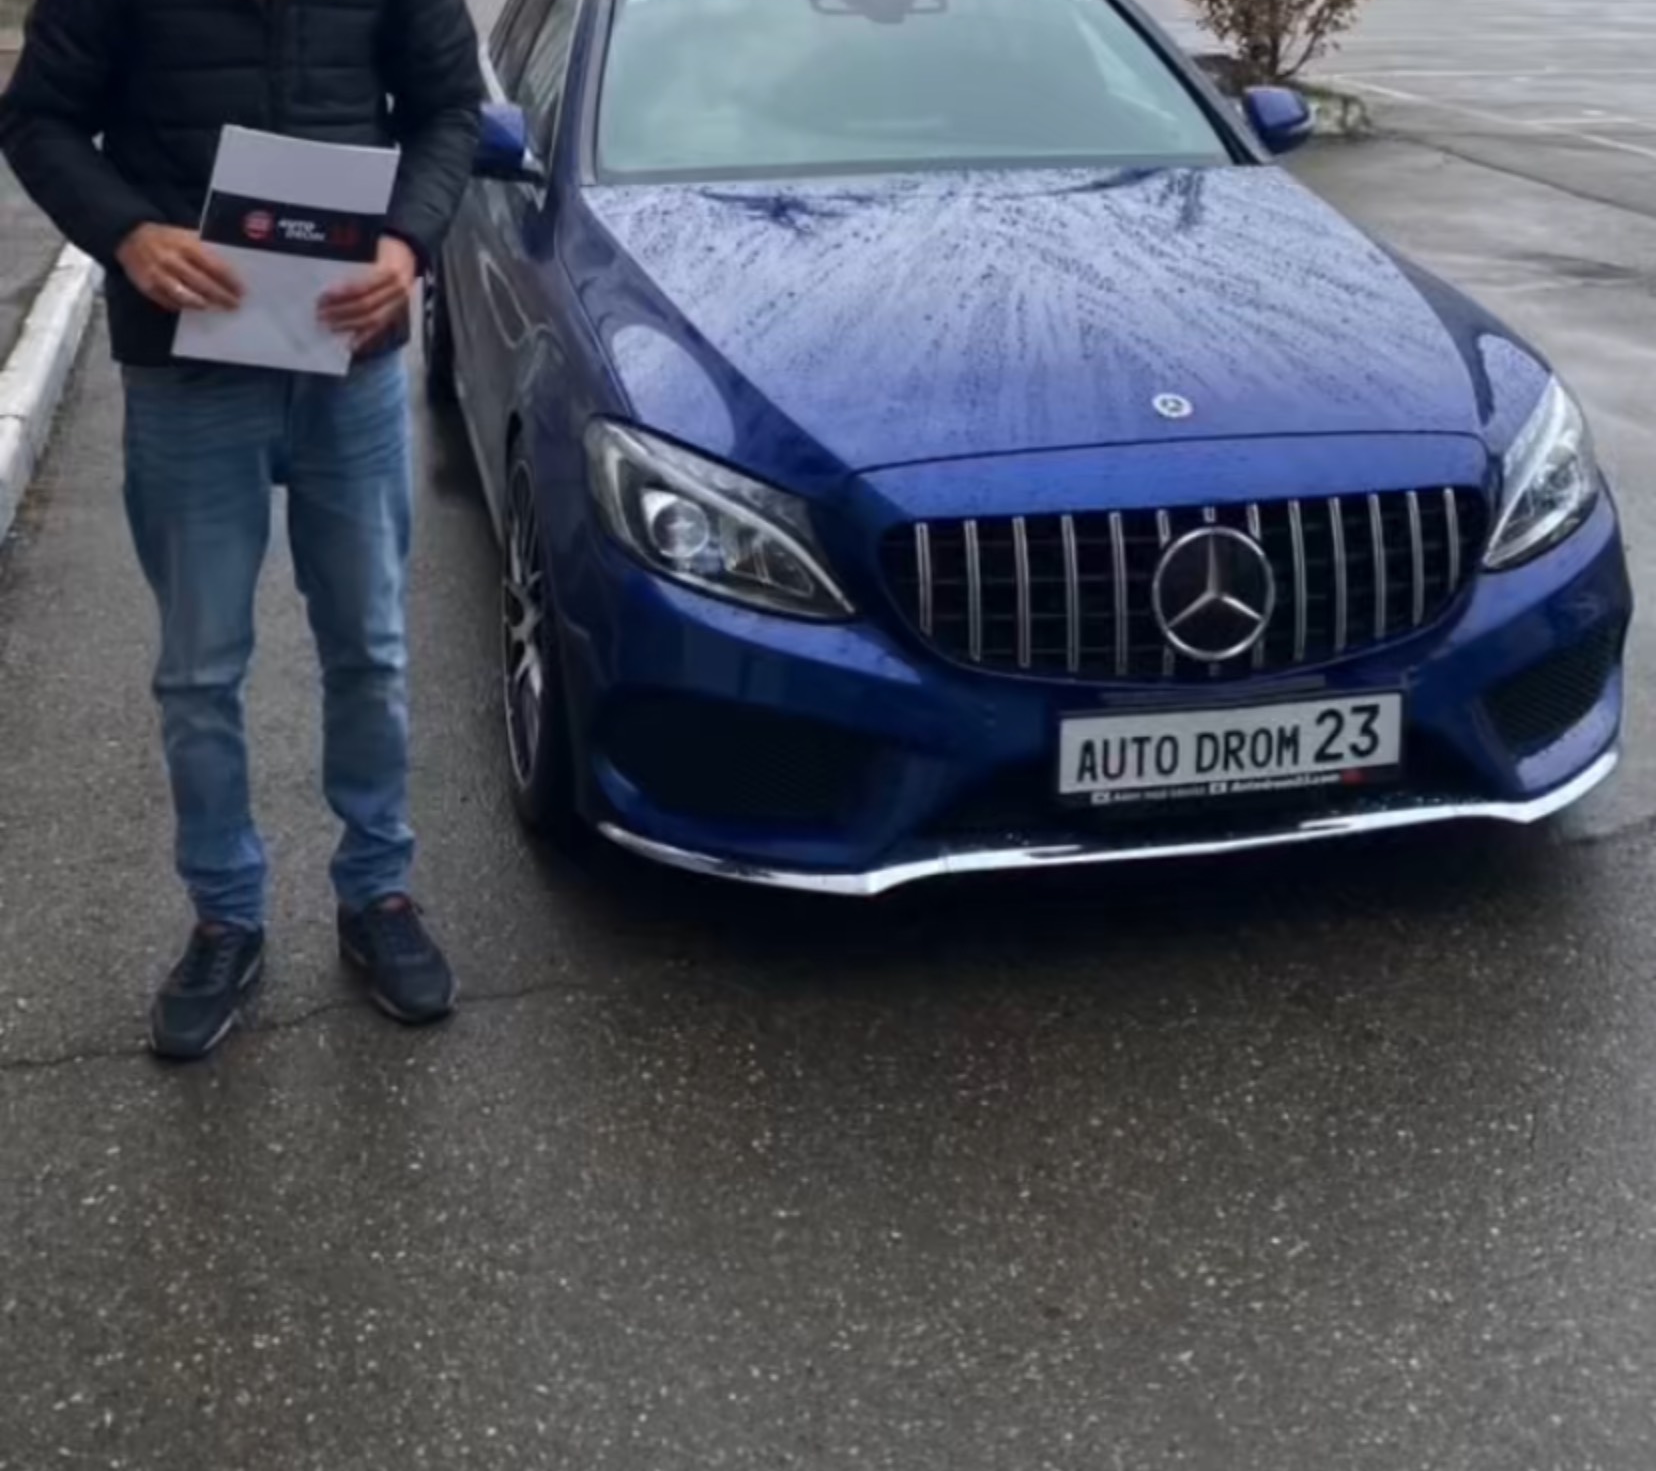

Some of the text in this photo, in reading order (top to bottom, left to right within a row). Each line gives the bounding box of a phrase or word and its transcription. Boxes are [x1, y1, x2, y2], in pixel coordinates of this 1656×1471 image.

[1077, 703, 1381, 782] AUTO DROM 23
